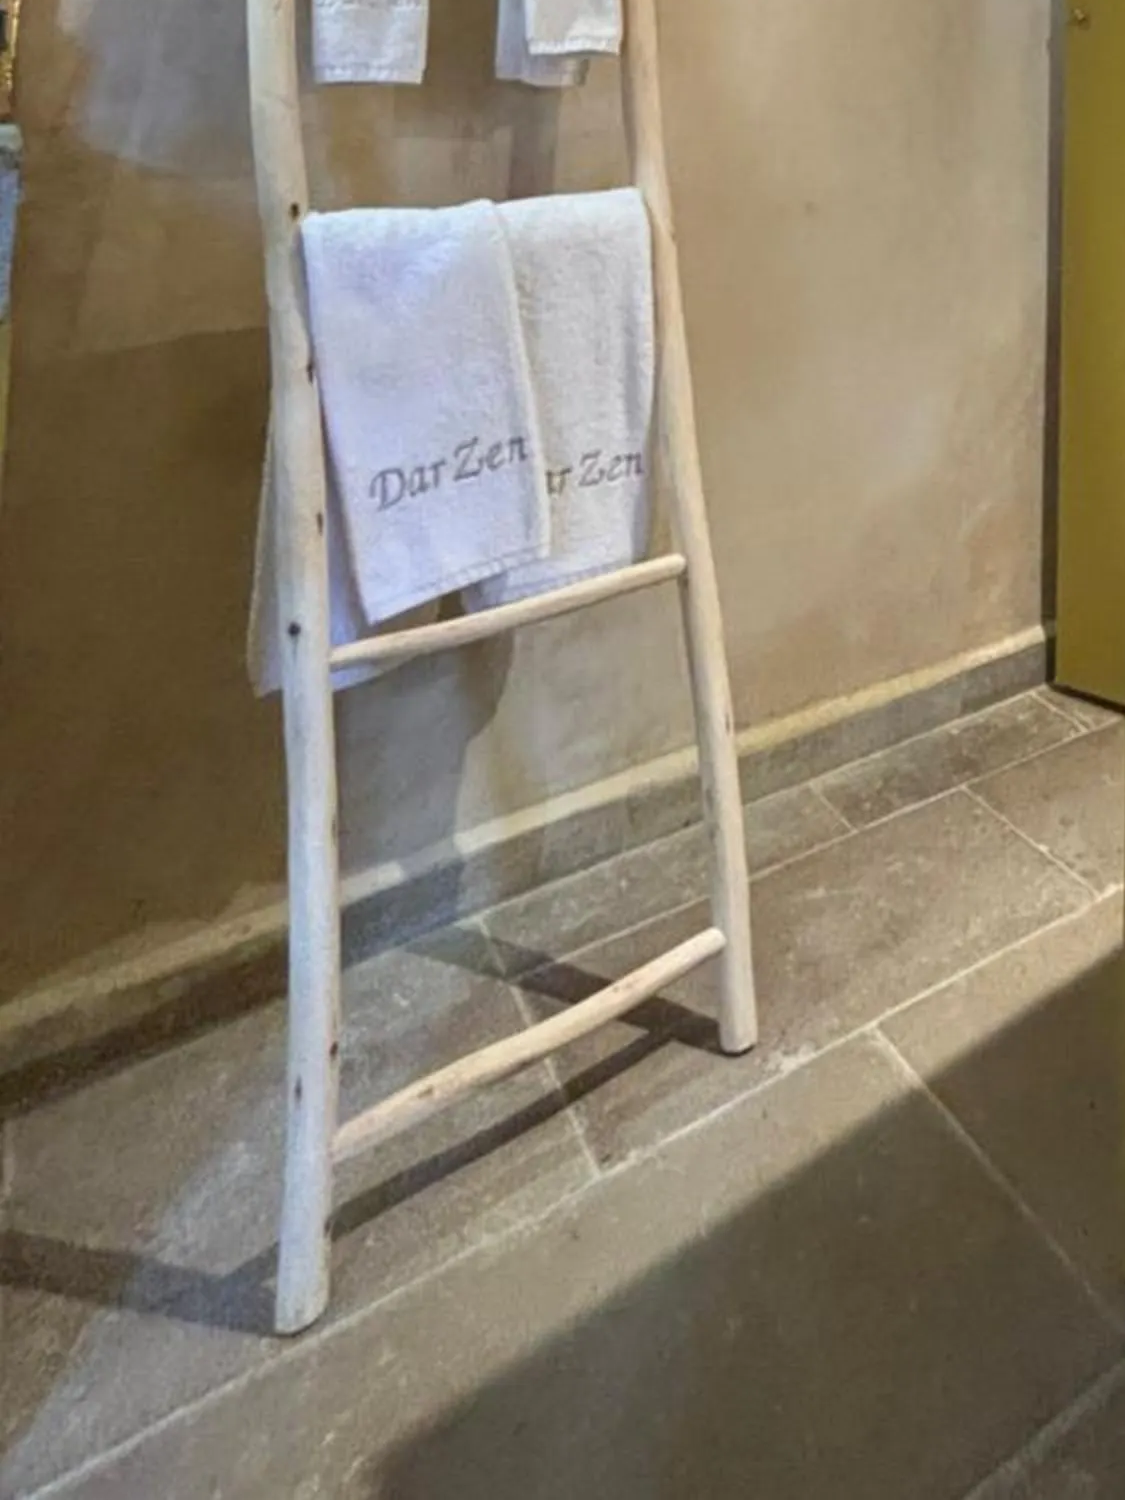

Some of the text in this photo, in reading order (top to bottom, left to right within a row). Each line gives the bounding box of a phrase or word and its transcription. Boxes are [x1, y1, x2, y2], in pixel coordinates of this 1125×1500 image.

[369, 436, 529, 512] Dar Zen
[578, 450, 645, 487] Zen
